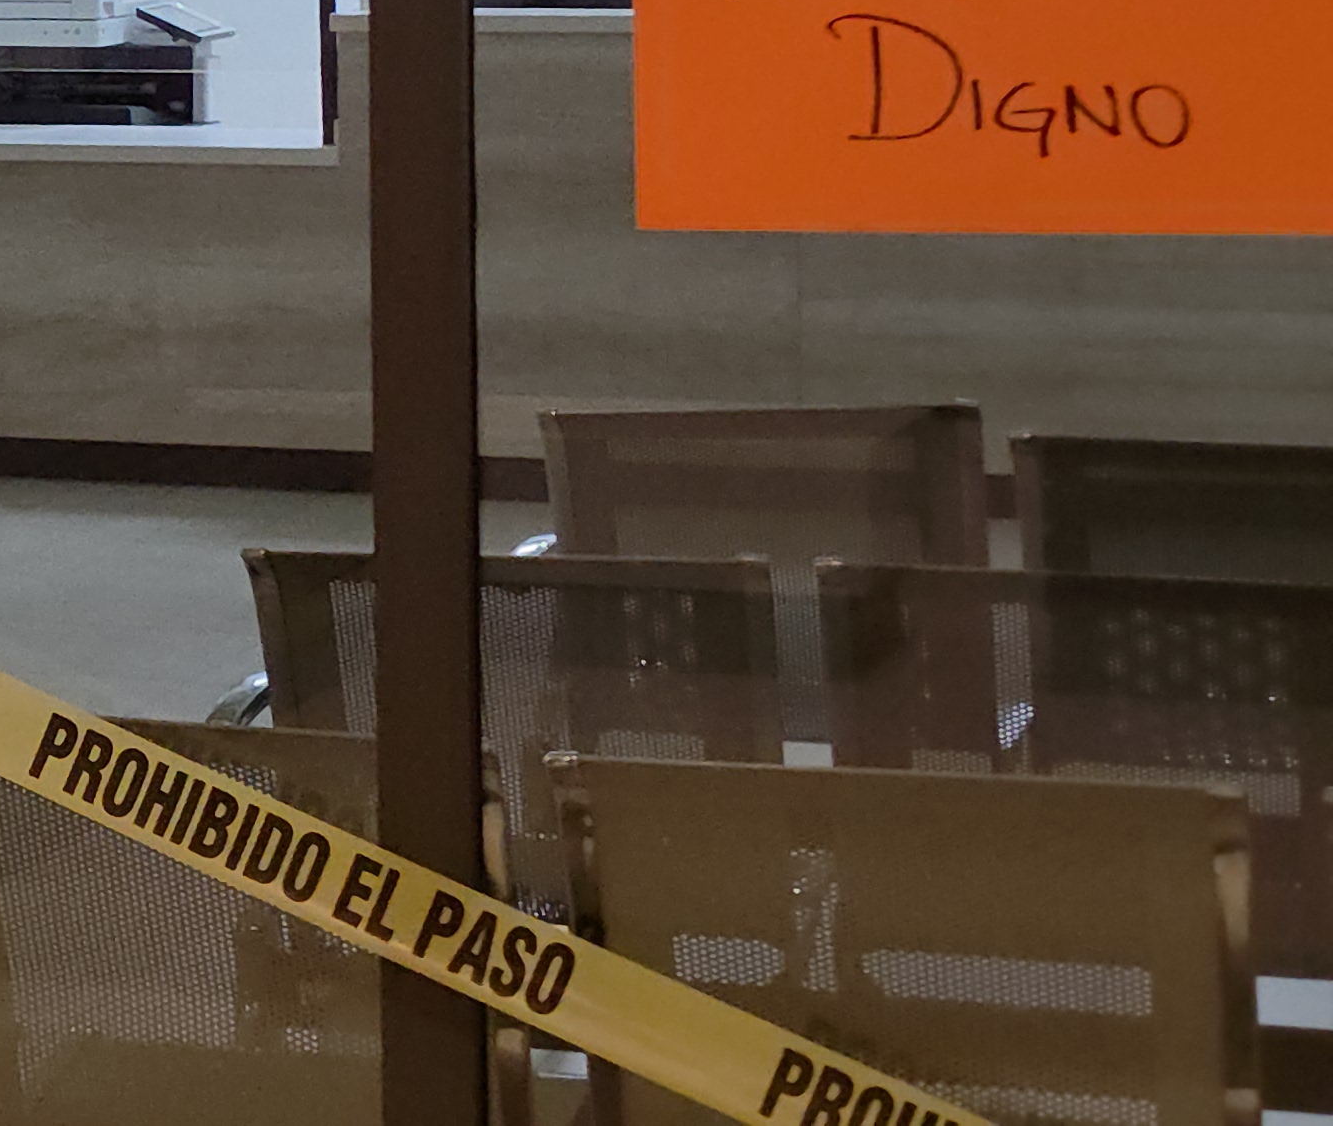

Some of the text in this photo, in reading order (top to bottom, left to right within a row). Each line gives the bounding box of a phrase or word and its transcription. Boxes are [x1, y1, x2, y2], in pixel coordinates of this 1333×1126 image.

[827, 14, 1189, 157] DIGNO
[29, 713, 575, 1015] PROHIBIDO EL PASO
